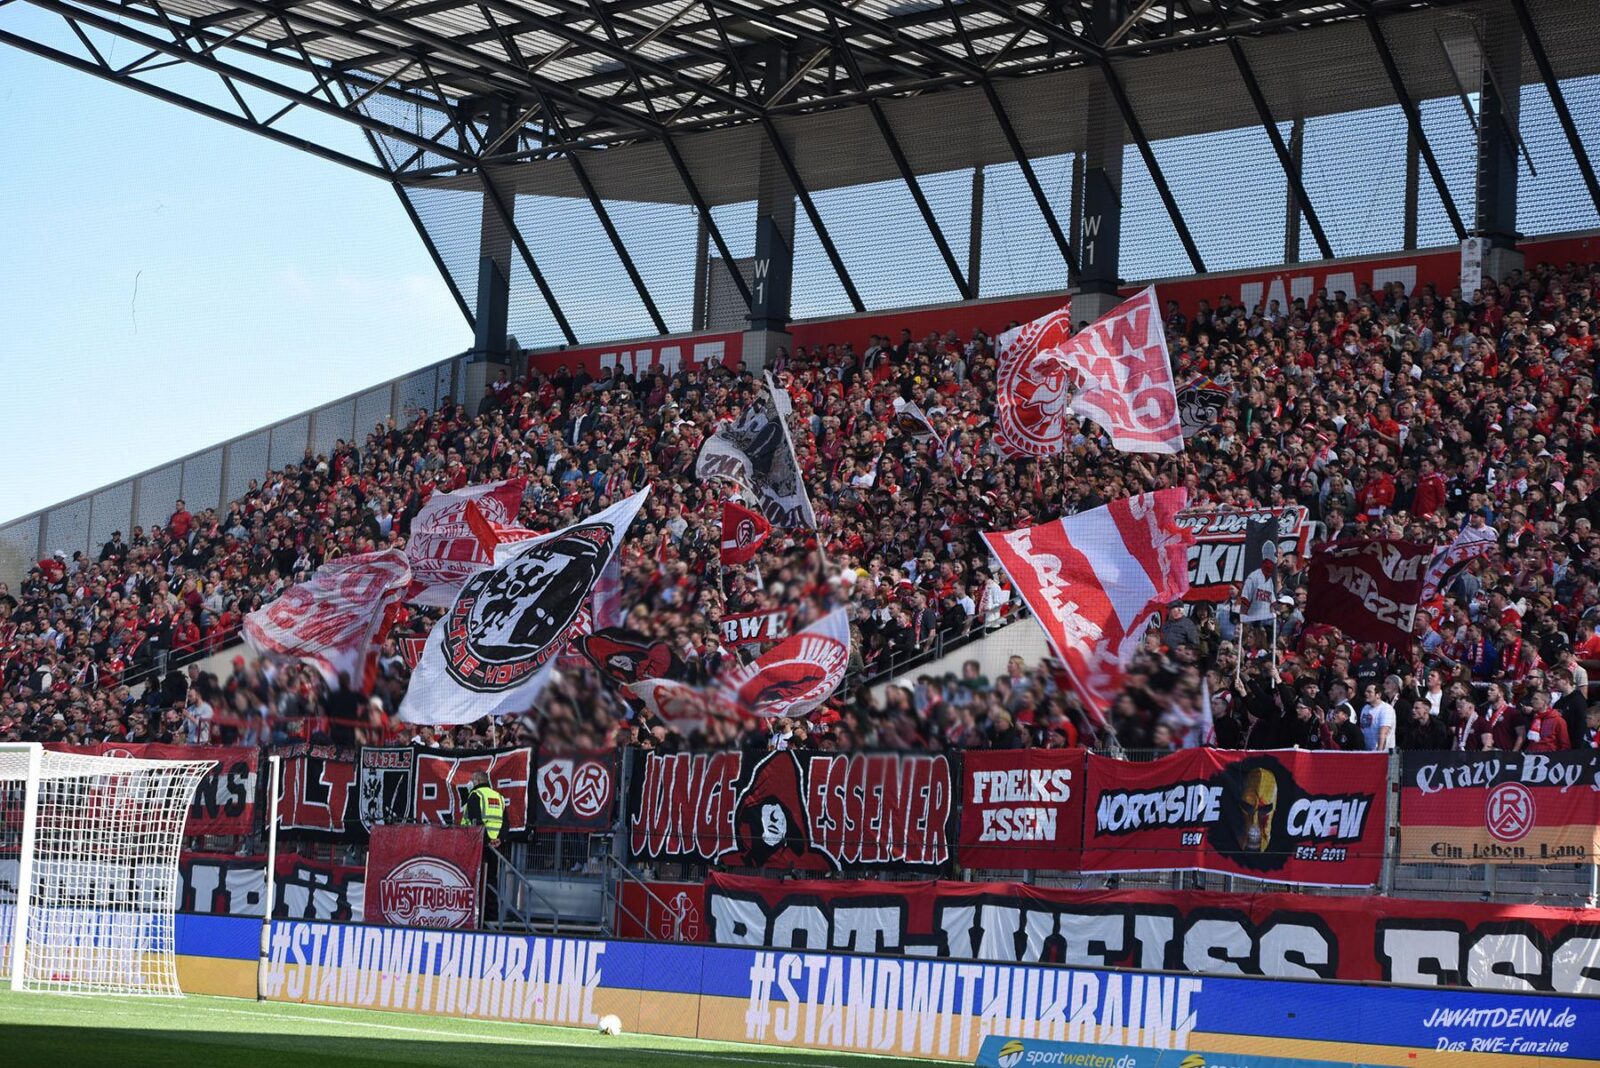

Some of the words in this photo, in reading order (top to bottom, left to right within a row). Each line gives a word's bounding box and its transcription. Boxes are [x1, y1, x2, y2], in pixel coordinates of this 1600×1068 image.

[1083, 214, 1101, 237] W
[1086, 245, 1095, 265] 1
[755, 258, 770, 278] W
[756, 282, 764, 304] 1
[722, 612, 789, 642] RWE
[973, 769, 1072, 804] FREAKS
[631, 751, 742, 858] JUNGE
[806, 754, 953, 866] ESSENER
[979, 807, 1057, 842] ESSEN
[1286, 798, 1368, 840] CREW
[1295, 846, 1318, 861] EST.
[1320, 847, 1347, 861] 2011
[1431, 841, 1463, 859] Ein
[1472, 841, 1525, 859] Leben
[1540, 841, 1586, 860] Lang
[268, 921, 606, 1024] #STANDWITHUKRAINE
[745, 951, 1203, 1059] #STANDWITHUKRAINE
[1423, 1007, 1577, 1028] JAWATTDENN.de
[1436, 1036, 1467, 1052] Das
[1470, 1037, 1569, 1054] RWE-Fanzine
[1025, 1049, 1137, 1068] sportwetten.de
